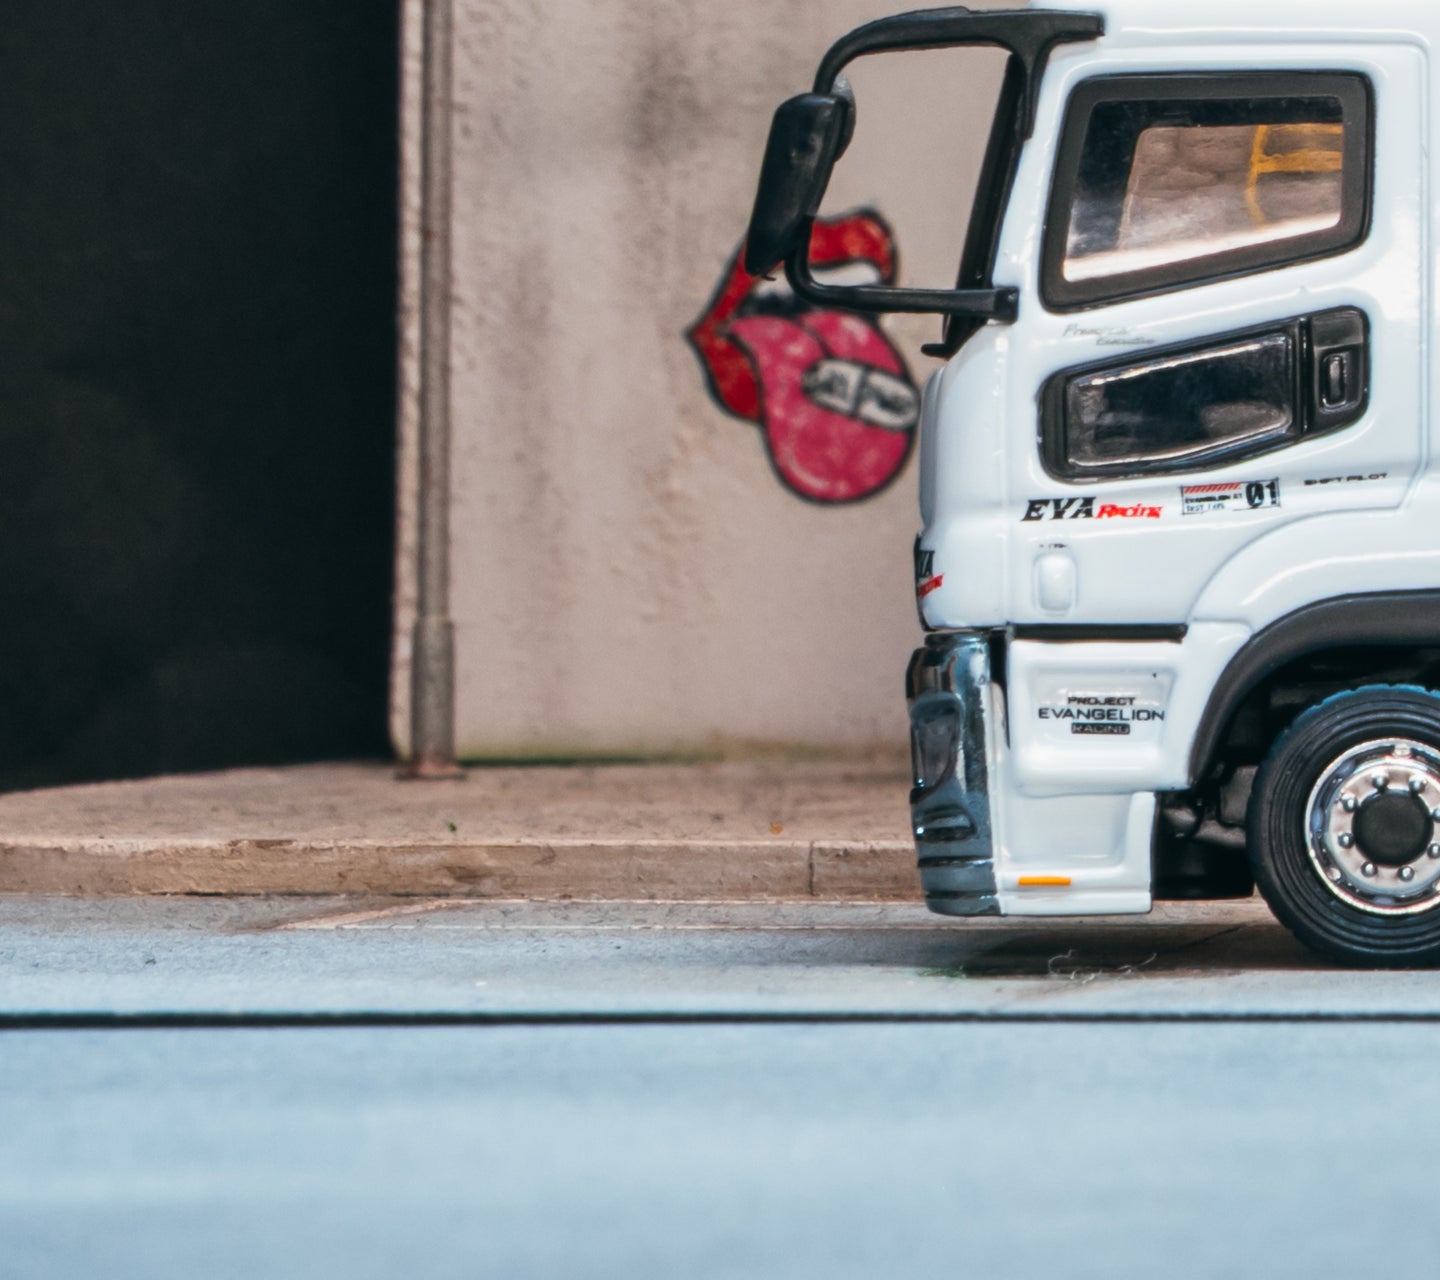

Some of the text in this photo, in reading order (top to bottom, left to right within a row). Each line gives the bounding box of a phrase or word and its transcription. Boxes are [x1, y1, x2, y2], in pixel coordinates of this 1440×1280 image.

[1245, 480, 1277, 510] 01
[1020, 495, 1163, 521] EVA Racing
[1067, 696, 1137, 706] PROJECT
[1038, 707, 1166, 721] EVANGELION
[1072, 724, 1130, 734] RACING
